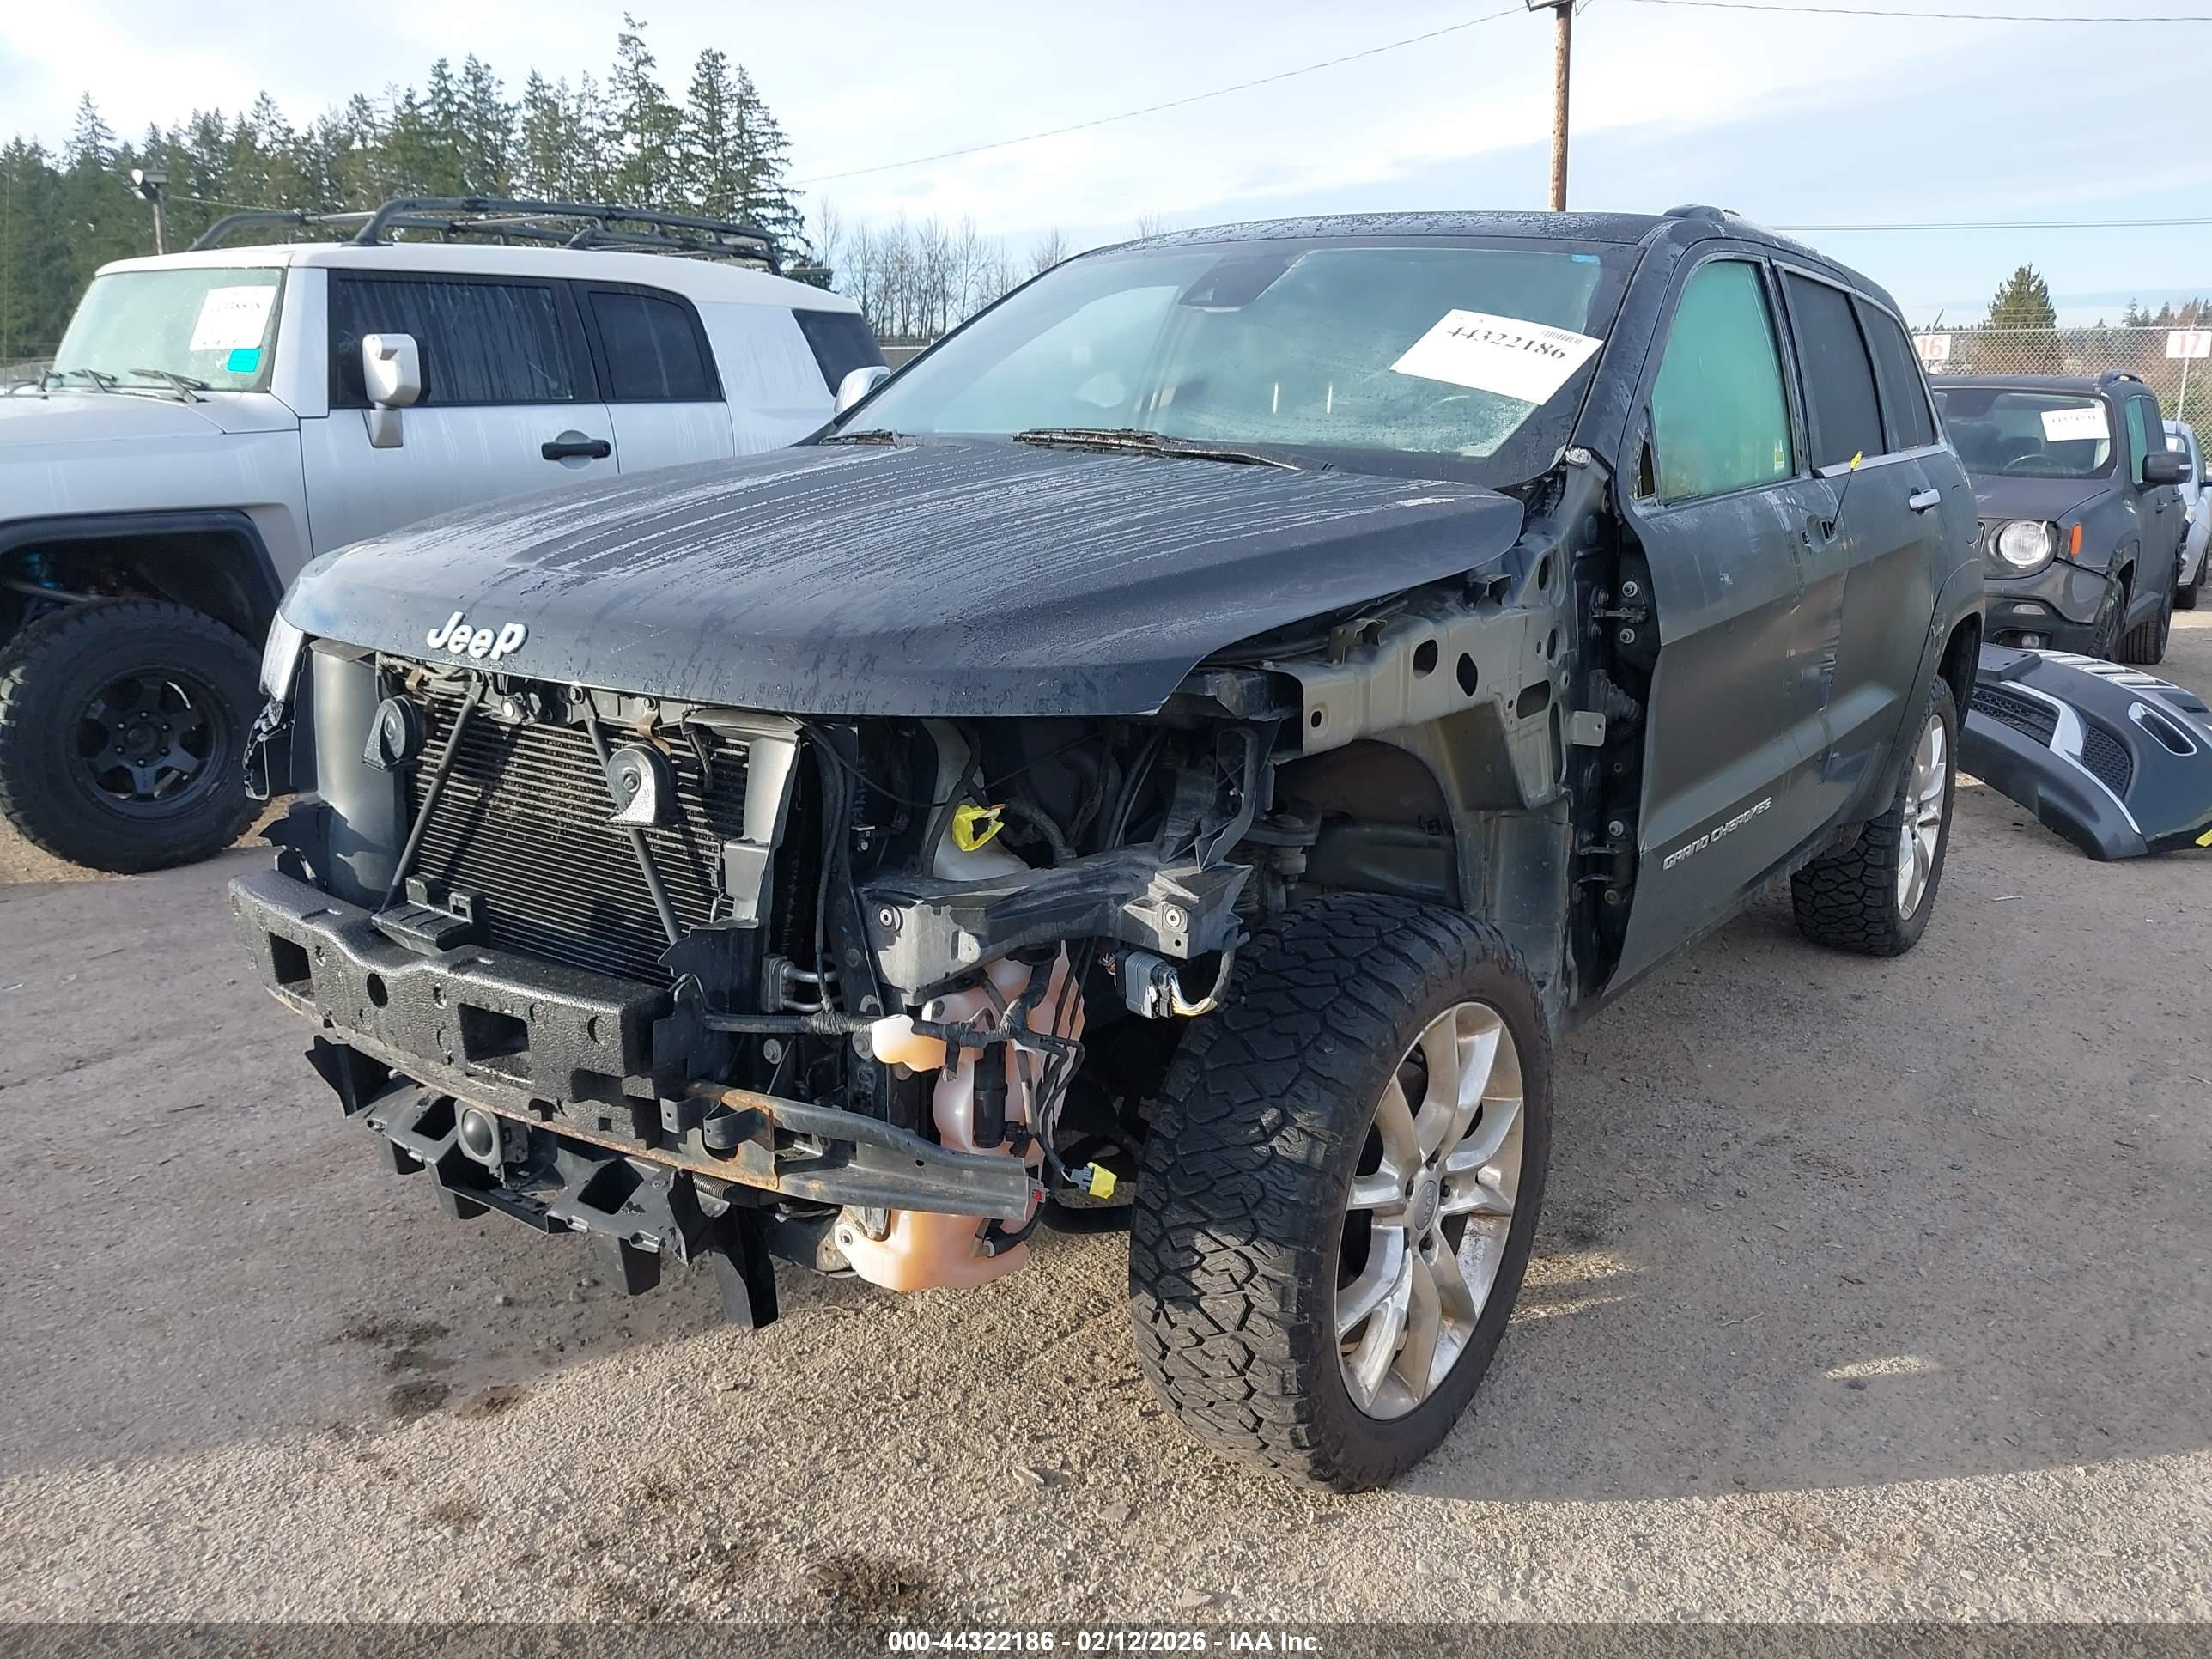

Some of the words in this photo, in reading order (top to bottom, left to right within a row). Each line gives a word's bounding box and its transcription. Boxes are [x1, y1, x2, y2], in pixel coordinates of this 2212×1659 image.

[1446, 326, 1565, 359] 44322186
[1920, 337, 1943, 358] 16
[2179, 333, 2202, 356] 17
[427, 611, 529, 660] Jeep
[1662, 834, 1710, 870] GRAND
